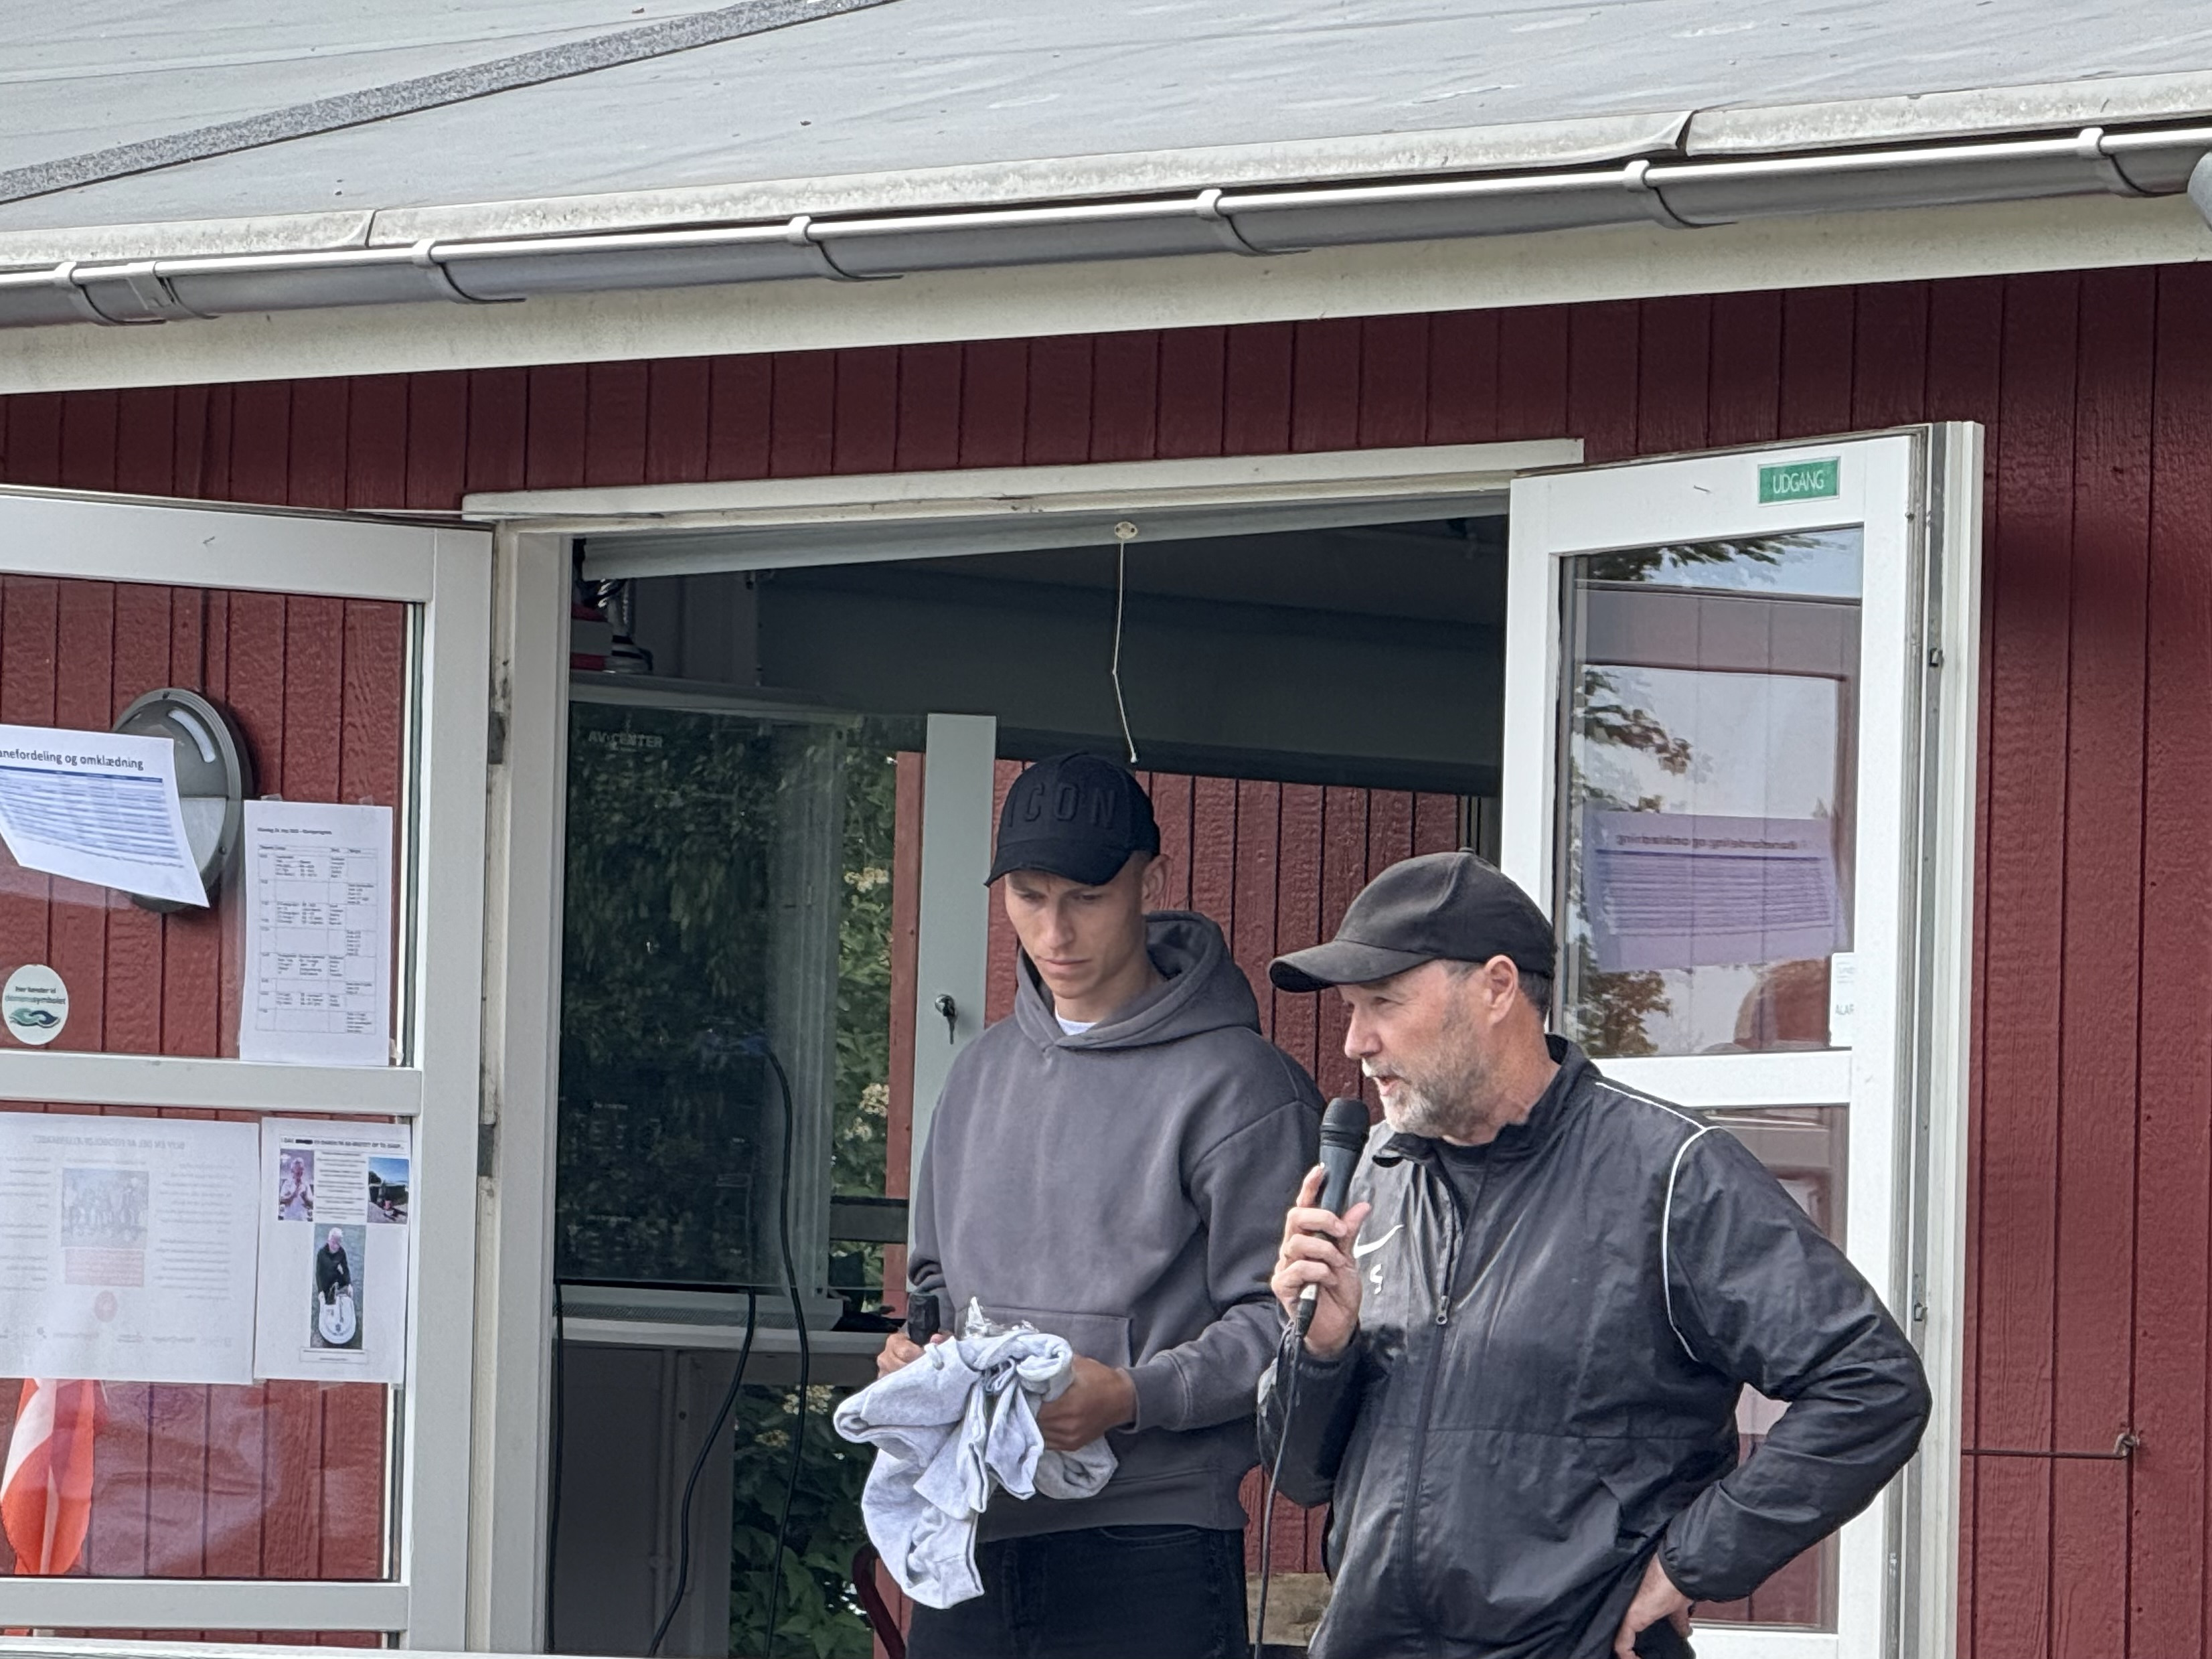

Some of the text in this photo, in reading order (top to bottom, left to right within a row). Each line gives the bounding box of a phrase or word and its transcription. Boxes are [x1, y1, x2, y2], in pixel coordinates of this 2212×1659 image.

[1773, 470, 1824, 494] UDGANG
[65, 755, 78, 767] og
[80, 755, 144, 771] omklædning
[1006, 781, 1117, 830] ICON
